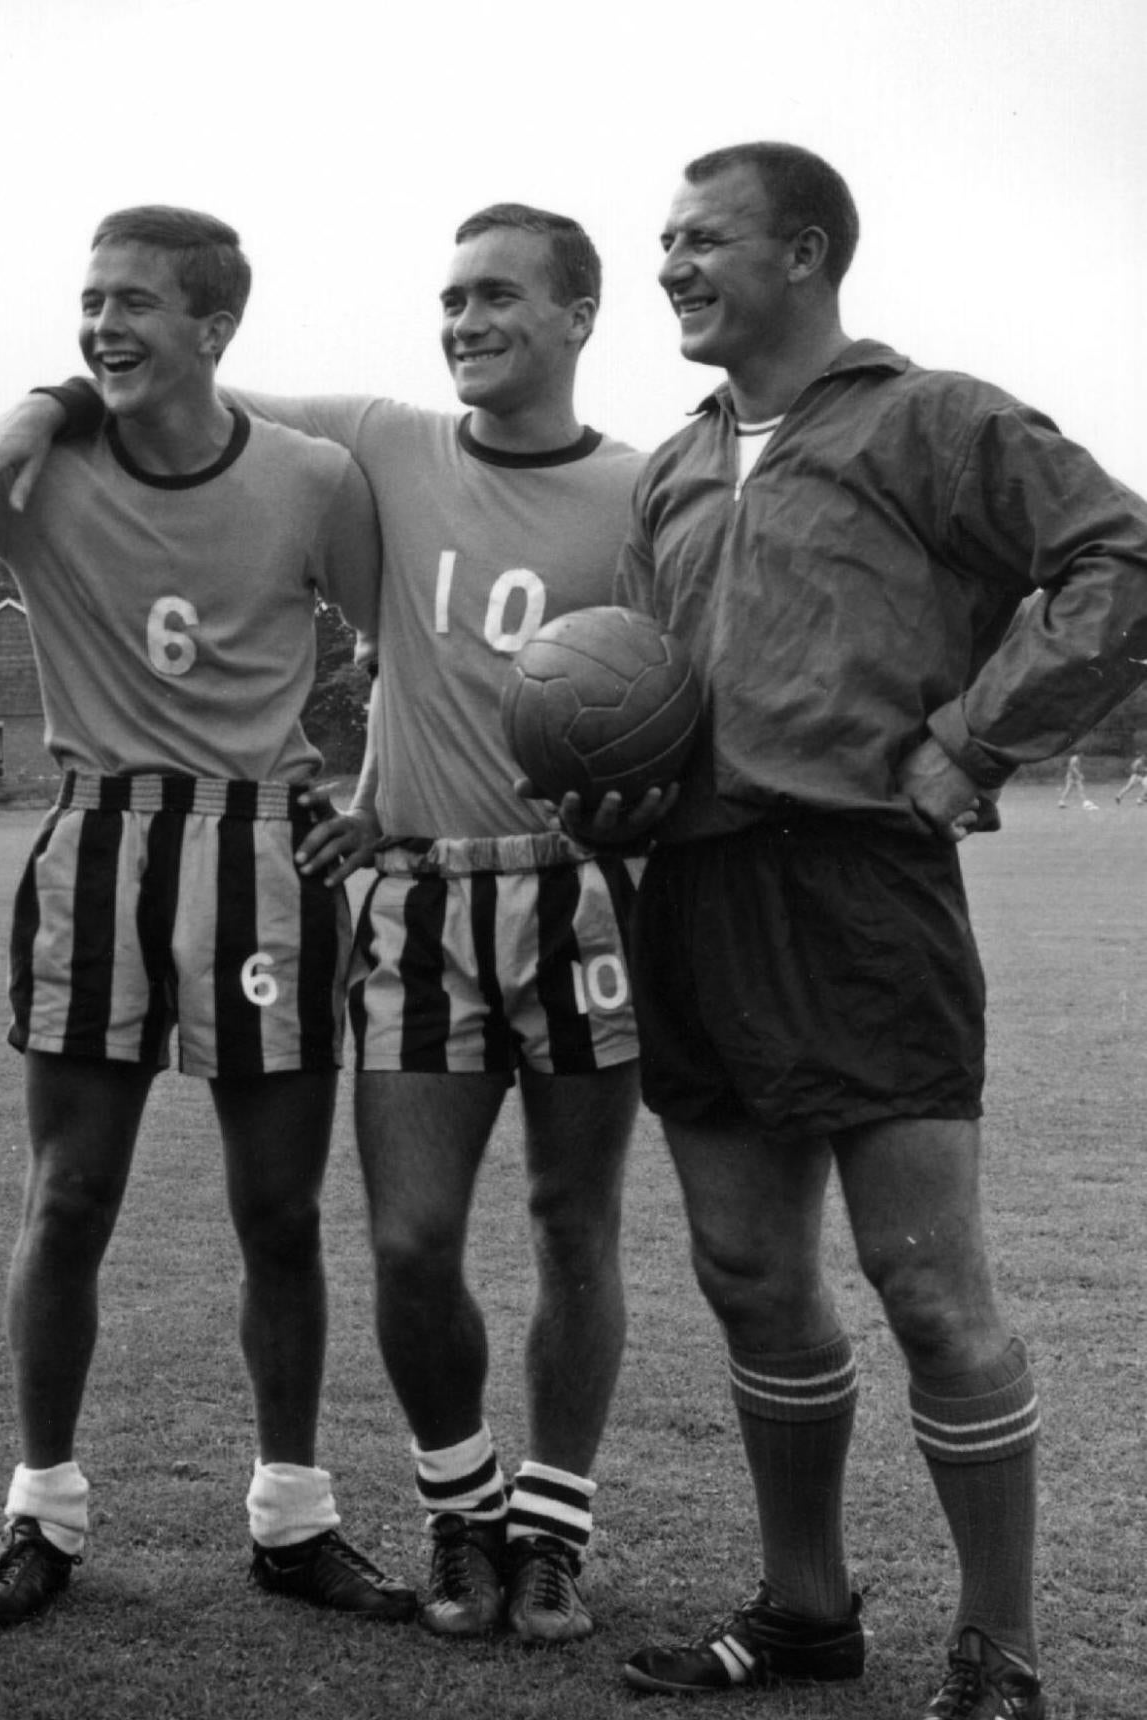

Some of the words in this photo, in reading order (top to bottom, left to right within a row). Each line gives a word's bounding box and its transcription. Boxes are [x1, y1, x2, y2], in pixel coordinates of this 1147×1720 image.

[147, 595, 199, 676] 6
[434, 550, 546, 651] 10
[241, 952, 277, 1007] 6
[571, 954, 628, 1014] 10
